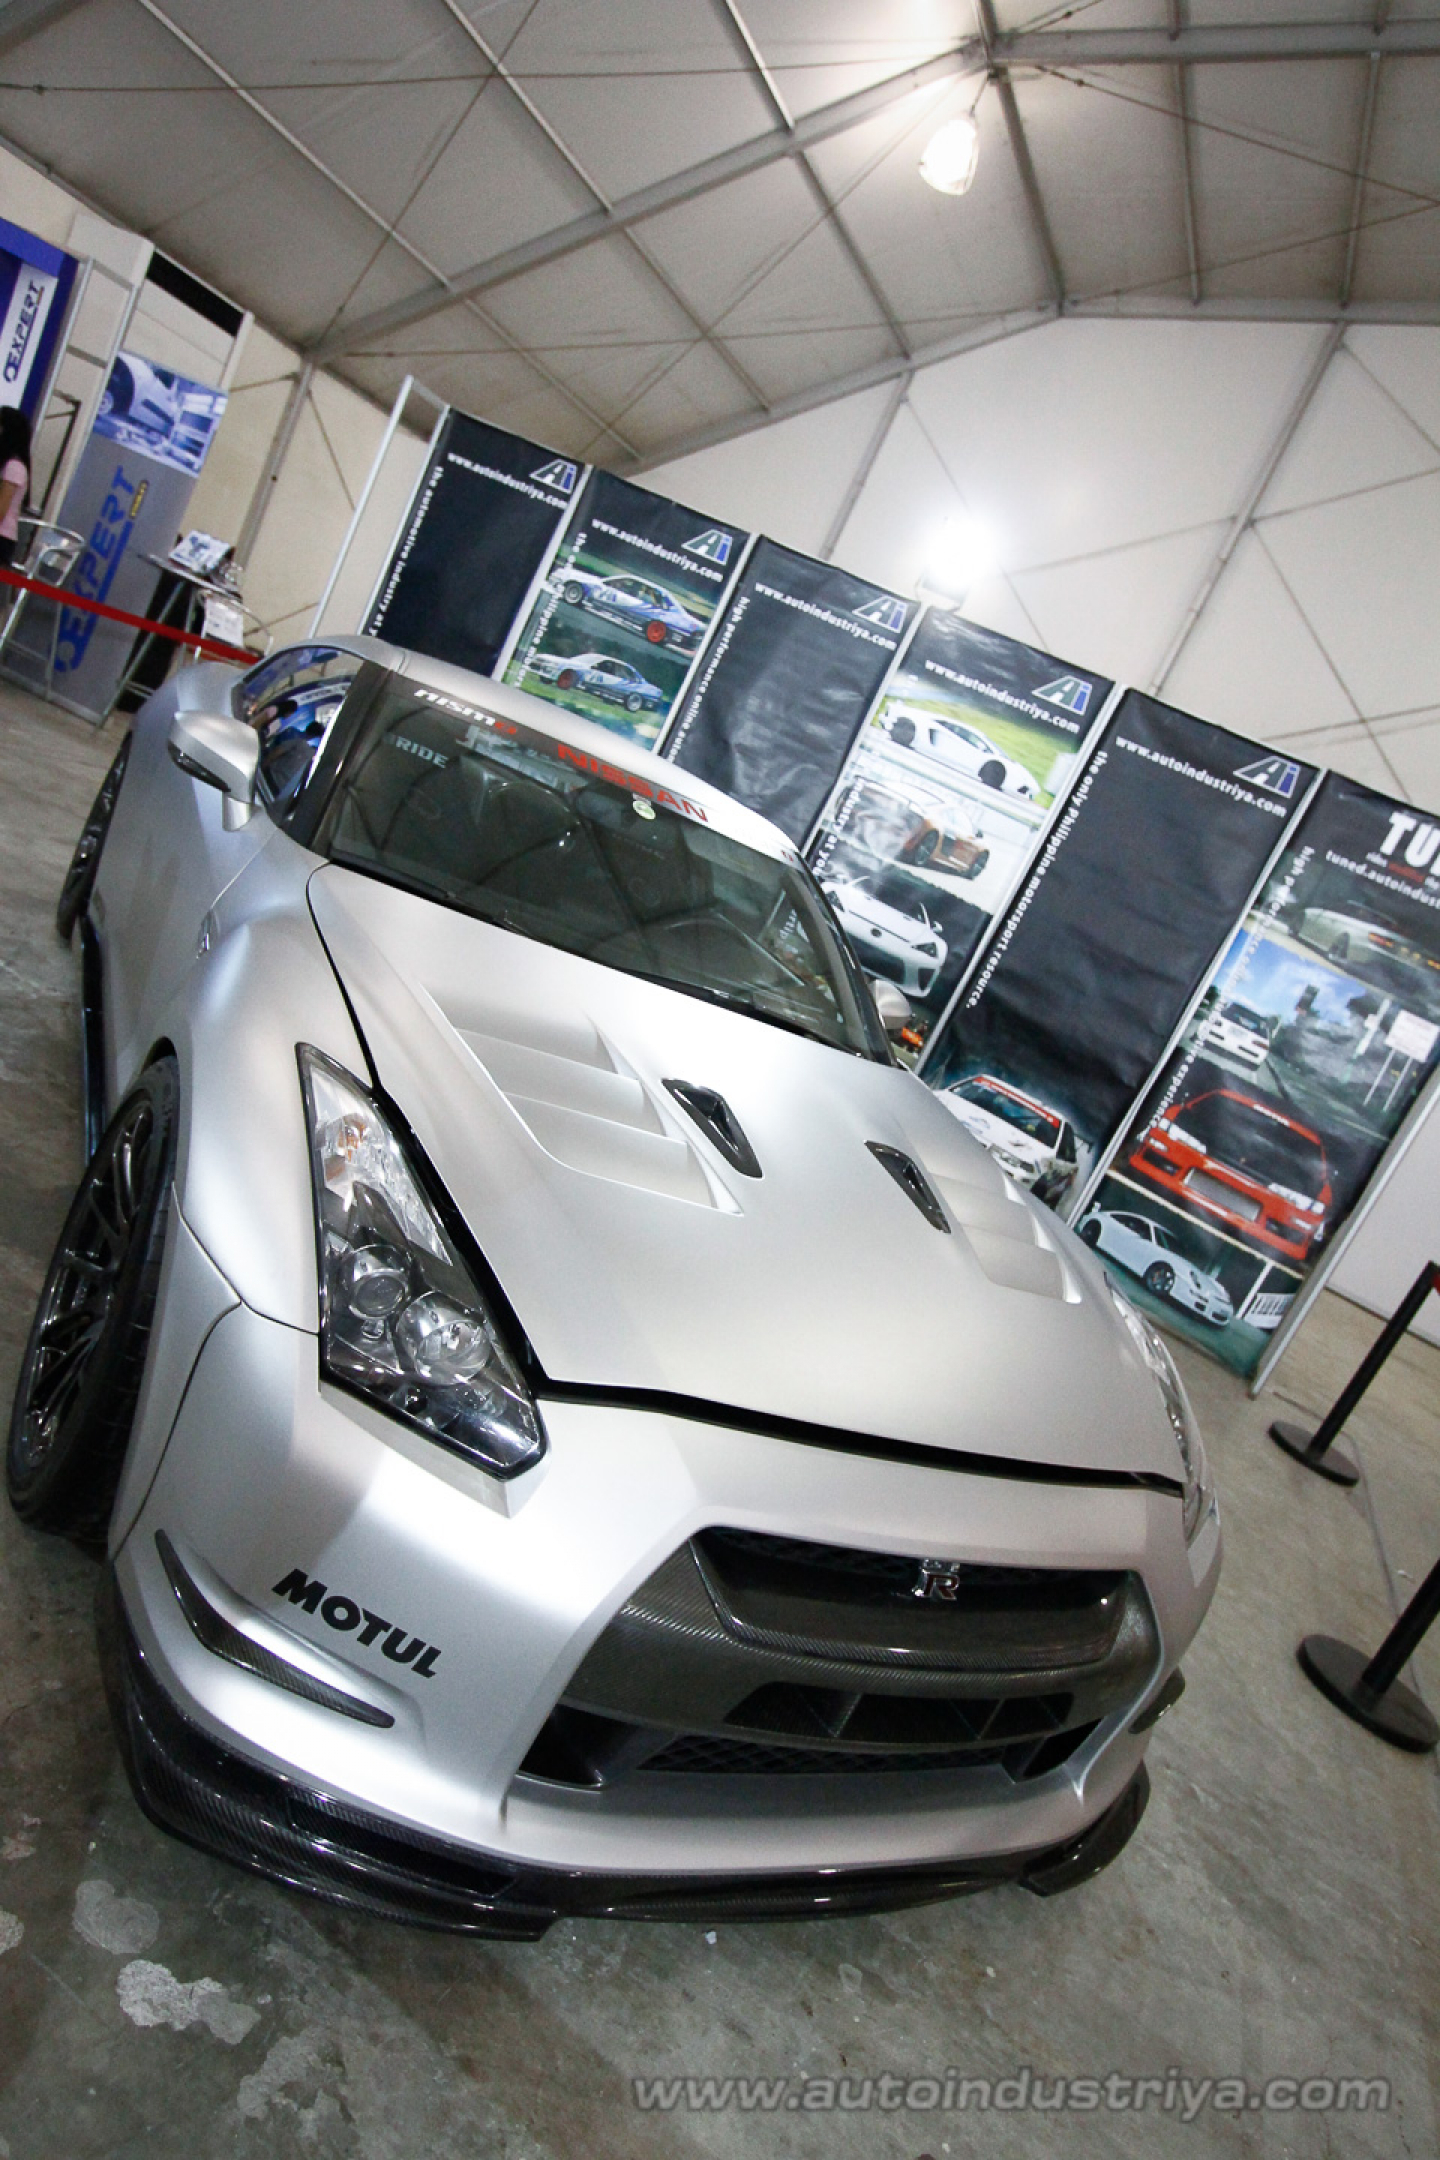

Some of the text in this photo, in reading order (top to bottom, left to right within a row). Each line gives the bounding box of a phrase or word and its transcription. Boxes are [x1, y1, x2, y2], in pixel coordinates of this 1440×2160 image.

[428, 466, 444, 487] the
[448, 453, 569, 510] www.autoindustriya.com
[401, 489, 432, 559] automotive
[571, 533, 588, 555] the
[592, 519, 723, 582] www.autoindustriya.com
[379, 560, 405, 613] industry
[731, 596, 751, 623] high
[755, 582, 897, 650] www.autoindustriya.com
[697, 622, 736, 694] performance
[682, 694, 703, 730] online
[925, 659, 1080, 733] www.autoindustriya.com
[558, 743, 707, 821] NISSAN
[1116, 735, 1286, 817] www.autoindustriya.com
[824, 834, 842, 850] at
[1290, 845, 1315, 876] high
[966, 750, 1108, 1009] the only Philippine motorsport resource.
[272, 1568, 442, 1678] MOTUL
